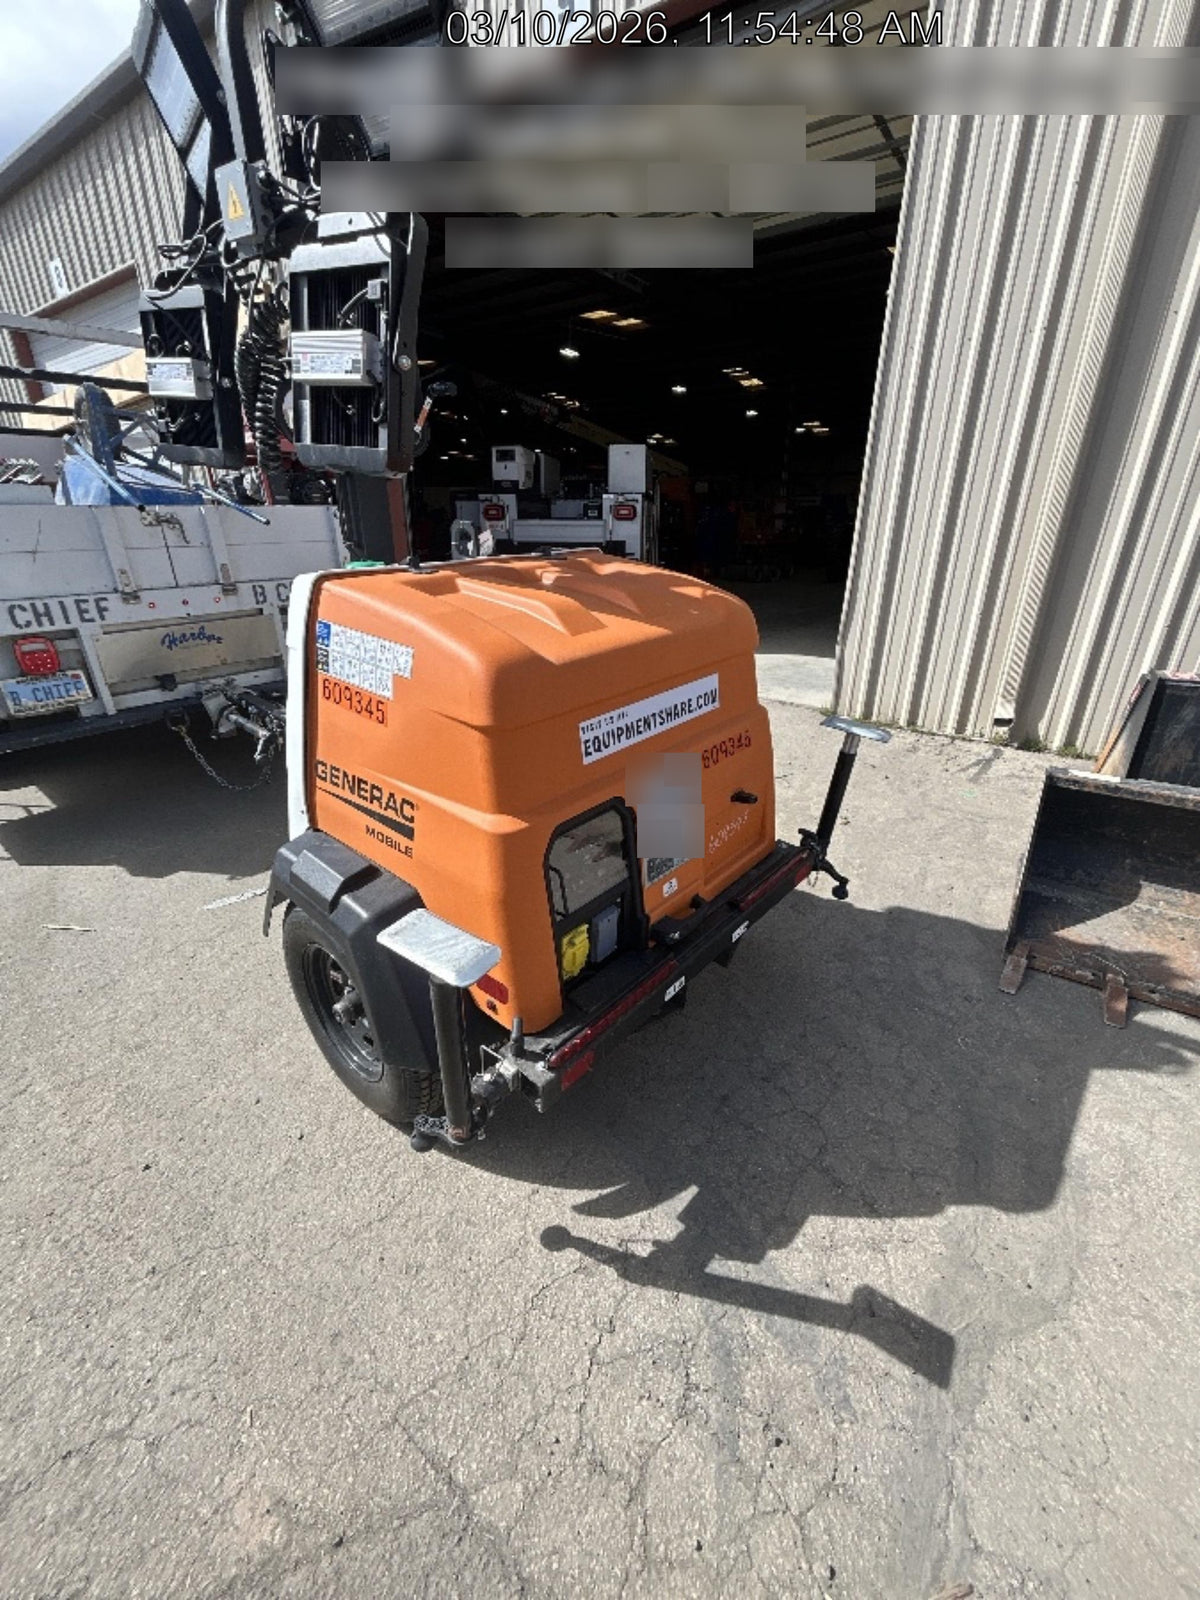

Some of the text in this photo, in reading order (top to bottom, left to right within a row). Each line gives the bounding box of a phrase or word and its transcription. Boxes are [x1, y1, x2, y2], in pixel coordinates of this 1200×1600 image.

[8, 597, 109, 629] CHIEF
[323, 679, 385, 724] 609345
[583, 688, 718, 758] EQUIPMENTSHARE.COM
[315, 760, 415, 824] GENERAC
[366, 824, 414, 859] MOBILE
